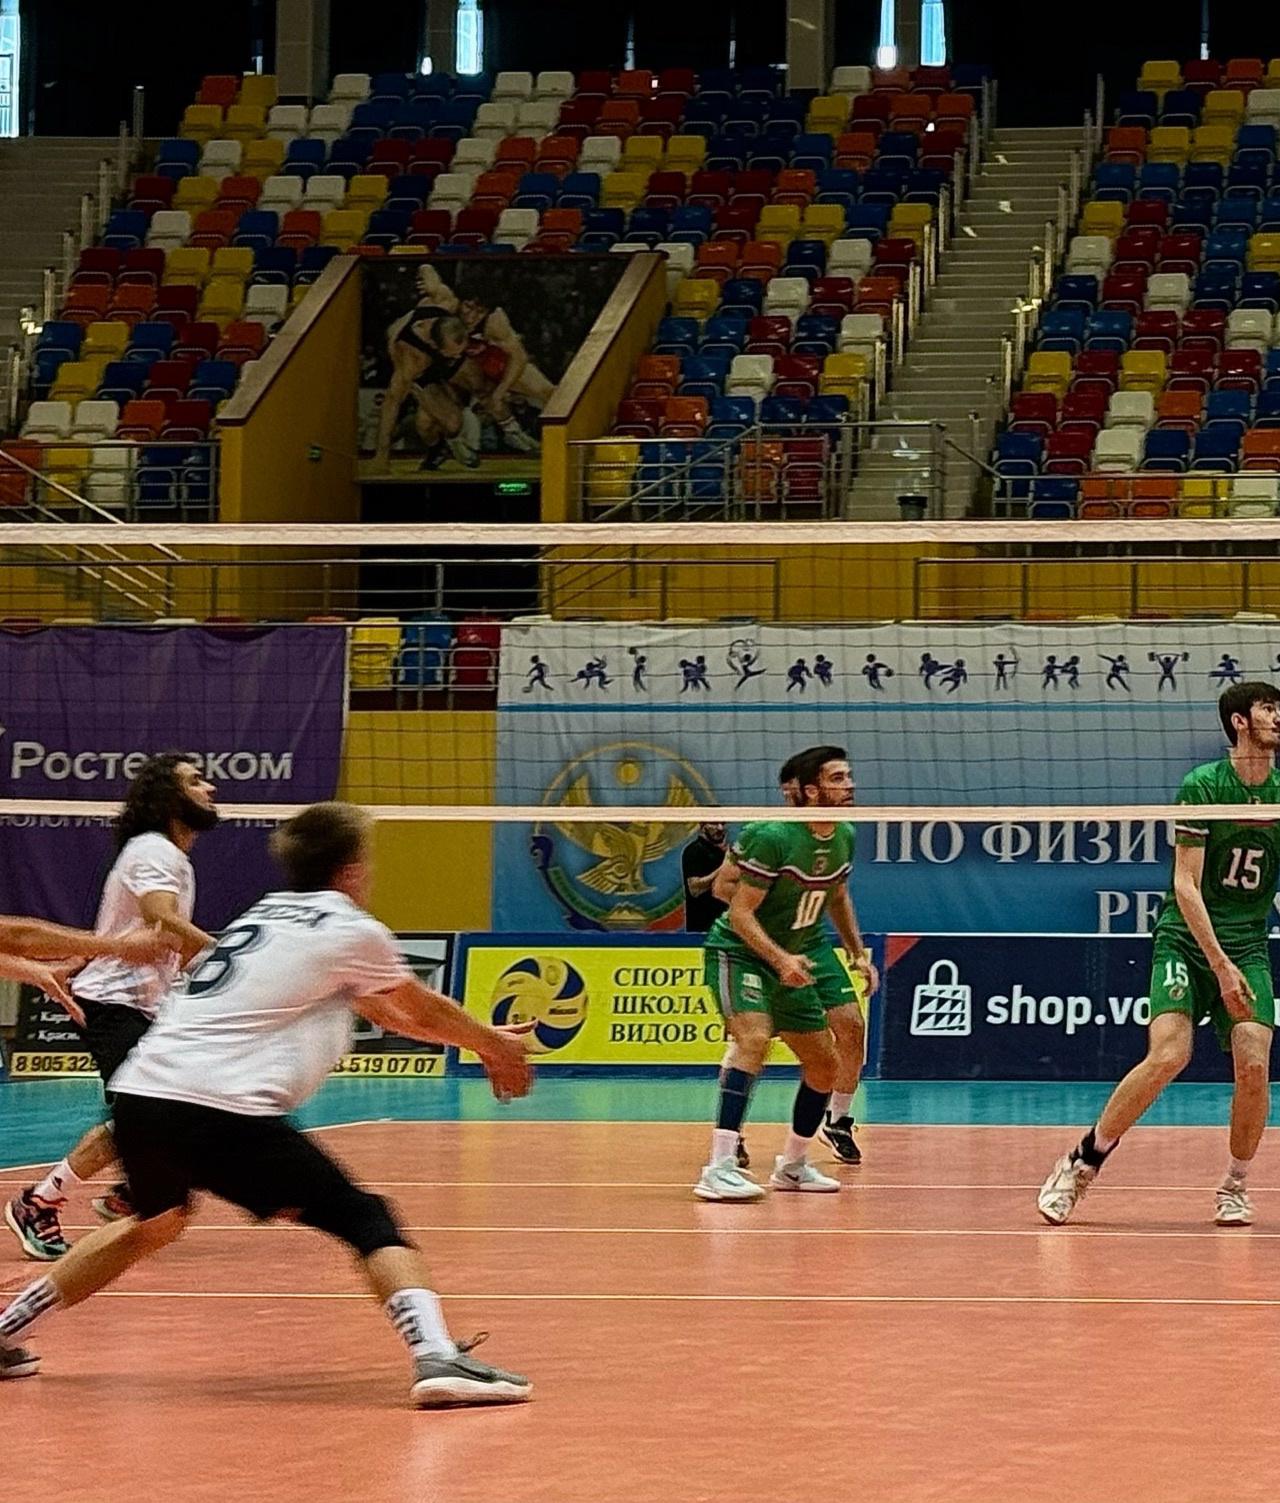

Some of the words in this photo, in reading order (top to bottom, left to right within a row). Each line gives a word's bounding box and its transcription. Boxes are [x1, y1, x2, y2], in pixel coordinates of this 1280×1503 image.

[10, 741, 293, 780] Ростеком
[1222, 847, 1265, 890] 15
[791, 890, 827, 929] 10
[188, 924, 262, 996] 8
[614, 967, 709, 987] СПОРТ
[1162, 959, 1190, 987] 15
[612, 995, 708, 1014] ШКОЛА
[609, 1023, 698, 1046] ВИДОВ
[16, 1056, 27, 1071] 8
[31, 1056, 63, 1071] 905
[350, 1058, 383, 1073] 519
[387, 1058, 410, 1073] 07
[414, 1058, 437, 1073] 07
